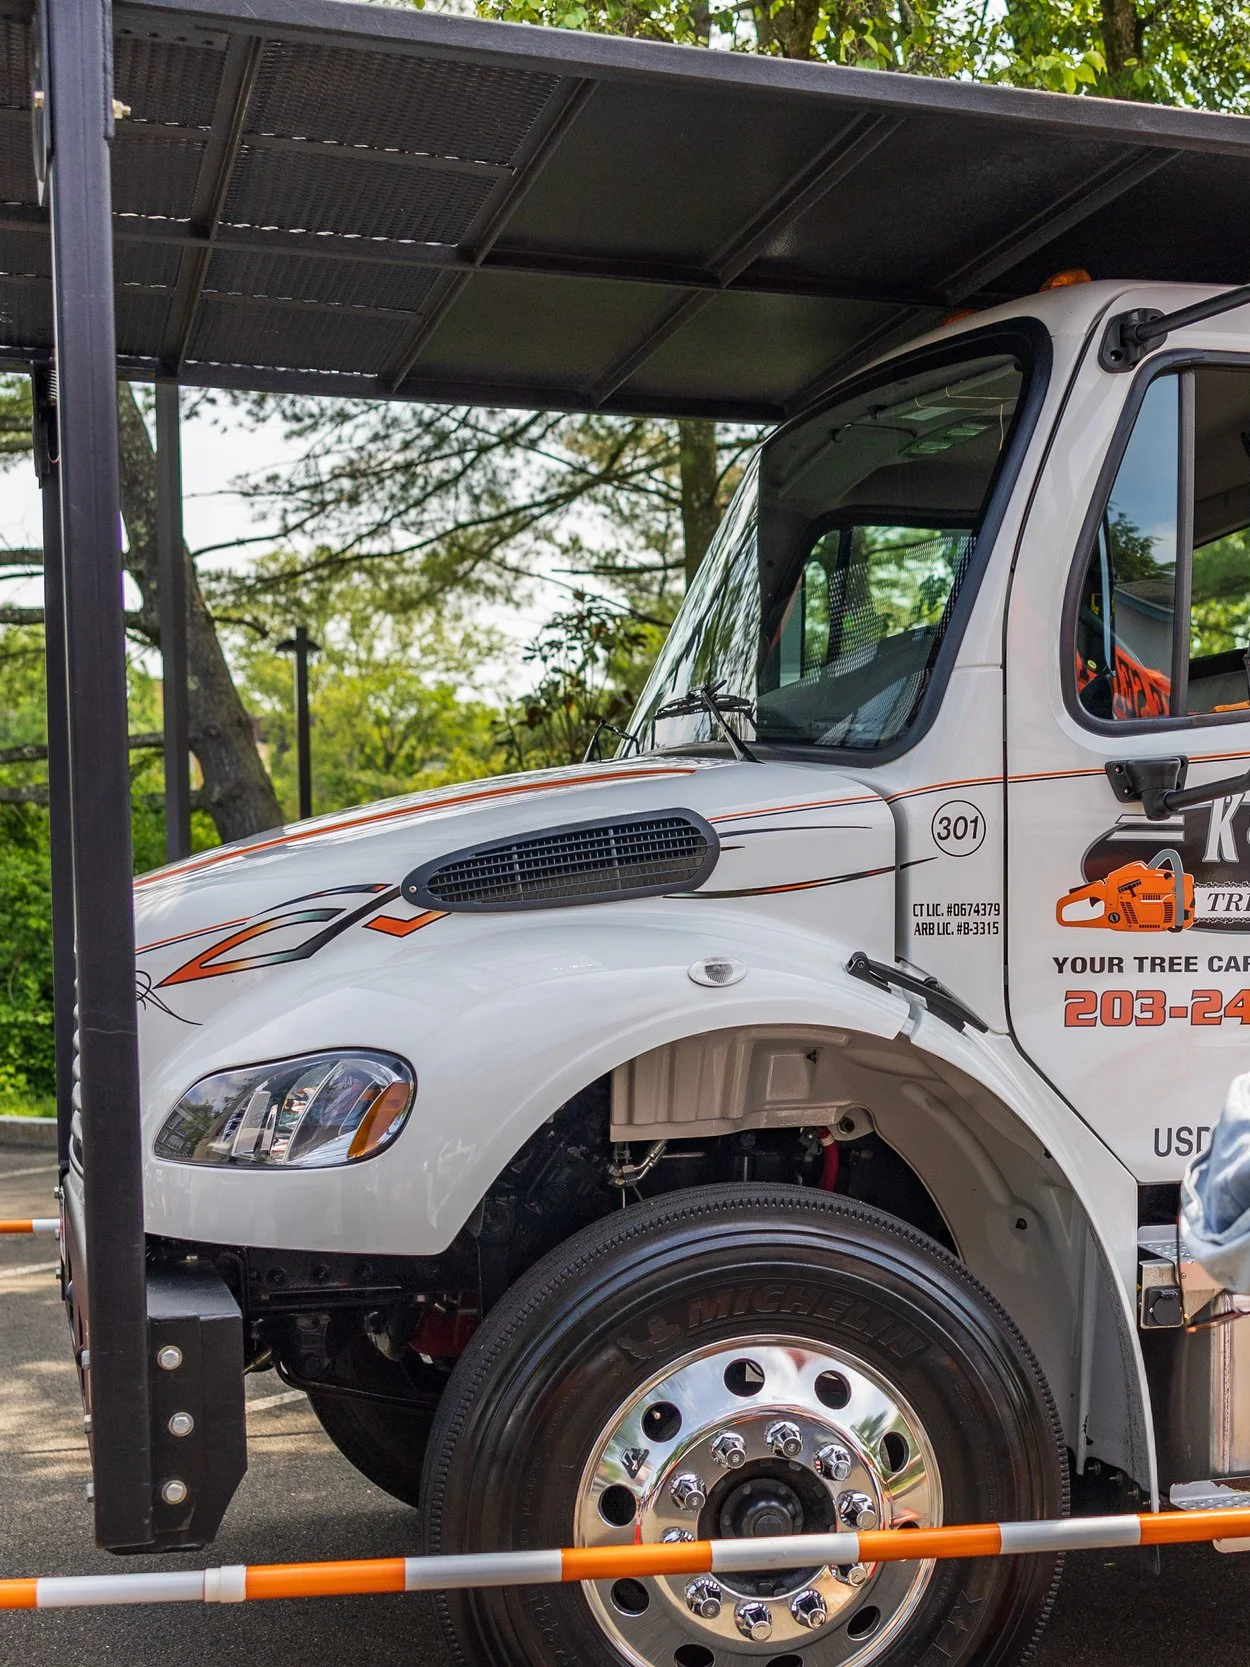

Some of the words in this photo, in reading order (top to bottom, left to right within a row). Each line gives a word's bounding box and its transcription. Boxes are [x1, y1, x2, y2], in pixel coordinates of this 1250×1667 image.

[936, 815, 980, 841] 301
[1202, 792, 1245, 862] K
[912, 903, 925, 917] CT
[926, 903, 944, 917] LIC.
[946, 902, 1001, 917] #0674379
[913, 922, 935, 936] ARB
[936, 922, 954, 936] LIC.
[956, 921, 999, 935] #B-3315
[1052, 956, 1125, 974] YOUR
[1133, 955, 1199, 973] TREE
[687, 1283, 928, 1359] MICHELIN
